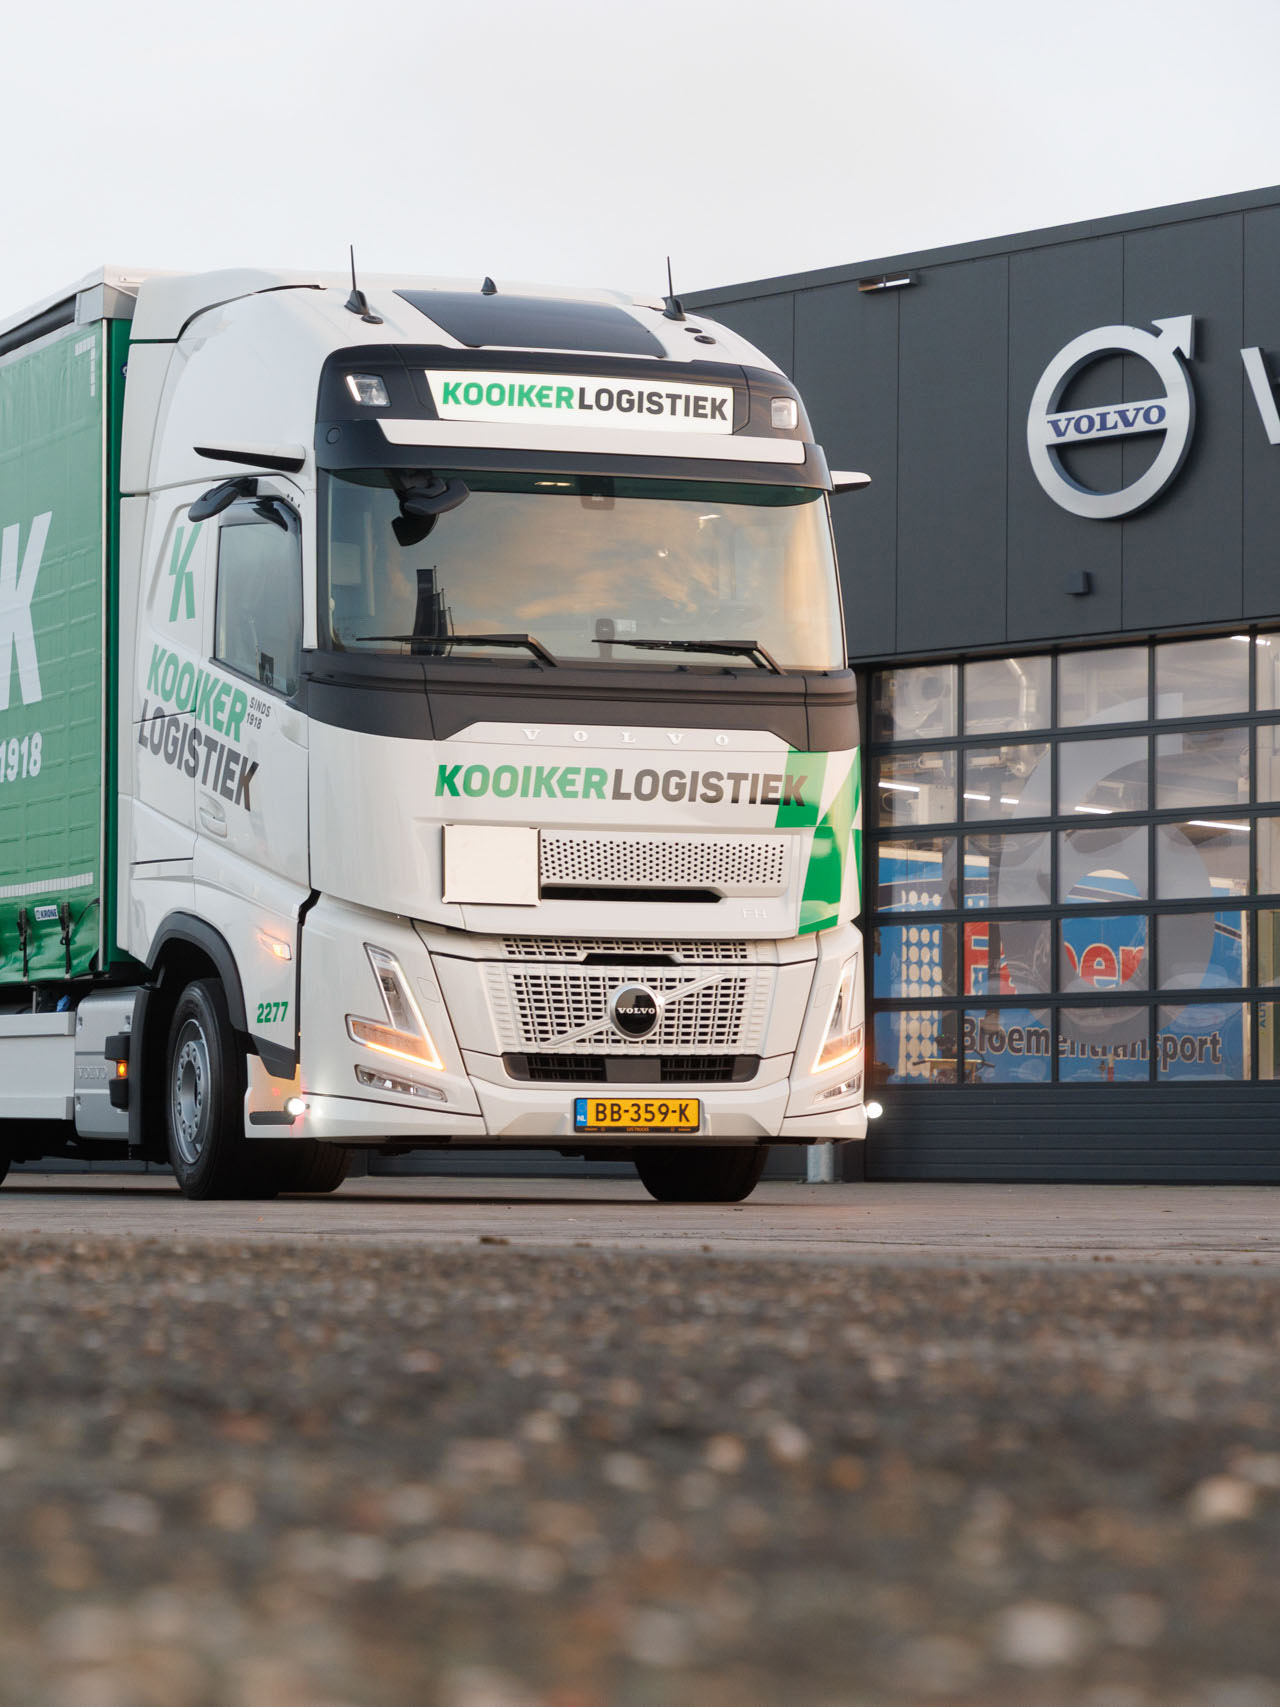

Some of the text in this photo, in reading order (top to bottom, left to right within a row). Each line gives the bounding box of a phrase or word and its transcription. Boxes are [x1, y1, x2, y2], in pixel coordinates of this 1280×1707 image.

[1046, 404, 1167, 438] VOLVO
[146, 643, 248, 744] KOOIKER
[249, 696, 271, 718] SINDS
[246, 711, 263, 730] 1918
[522, 728, 729, 747] VOLVO
[138, 698, 260, 812] LOGISTIEK
[256, 1001, 288, 1023] 2277
[616, 1007, 656, 1015] VOLVO
[595, 1102, 691, 1123] BB-359-K
